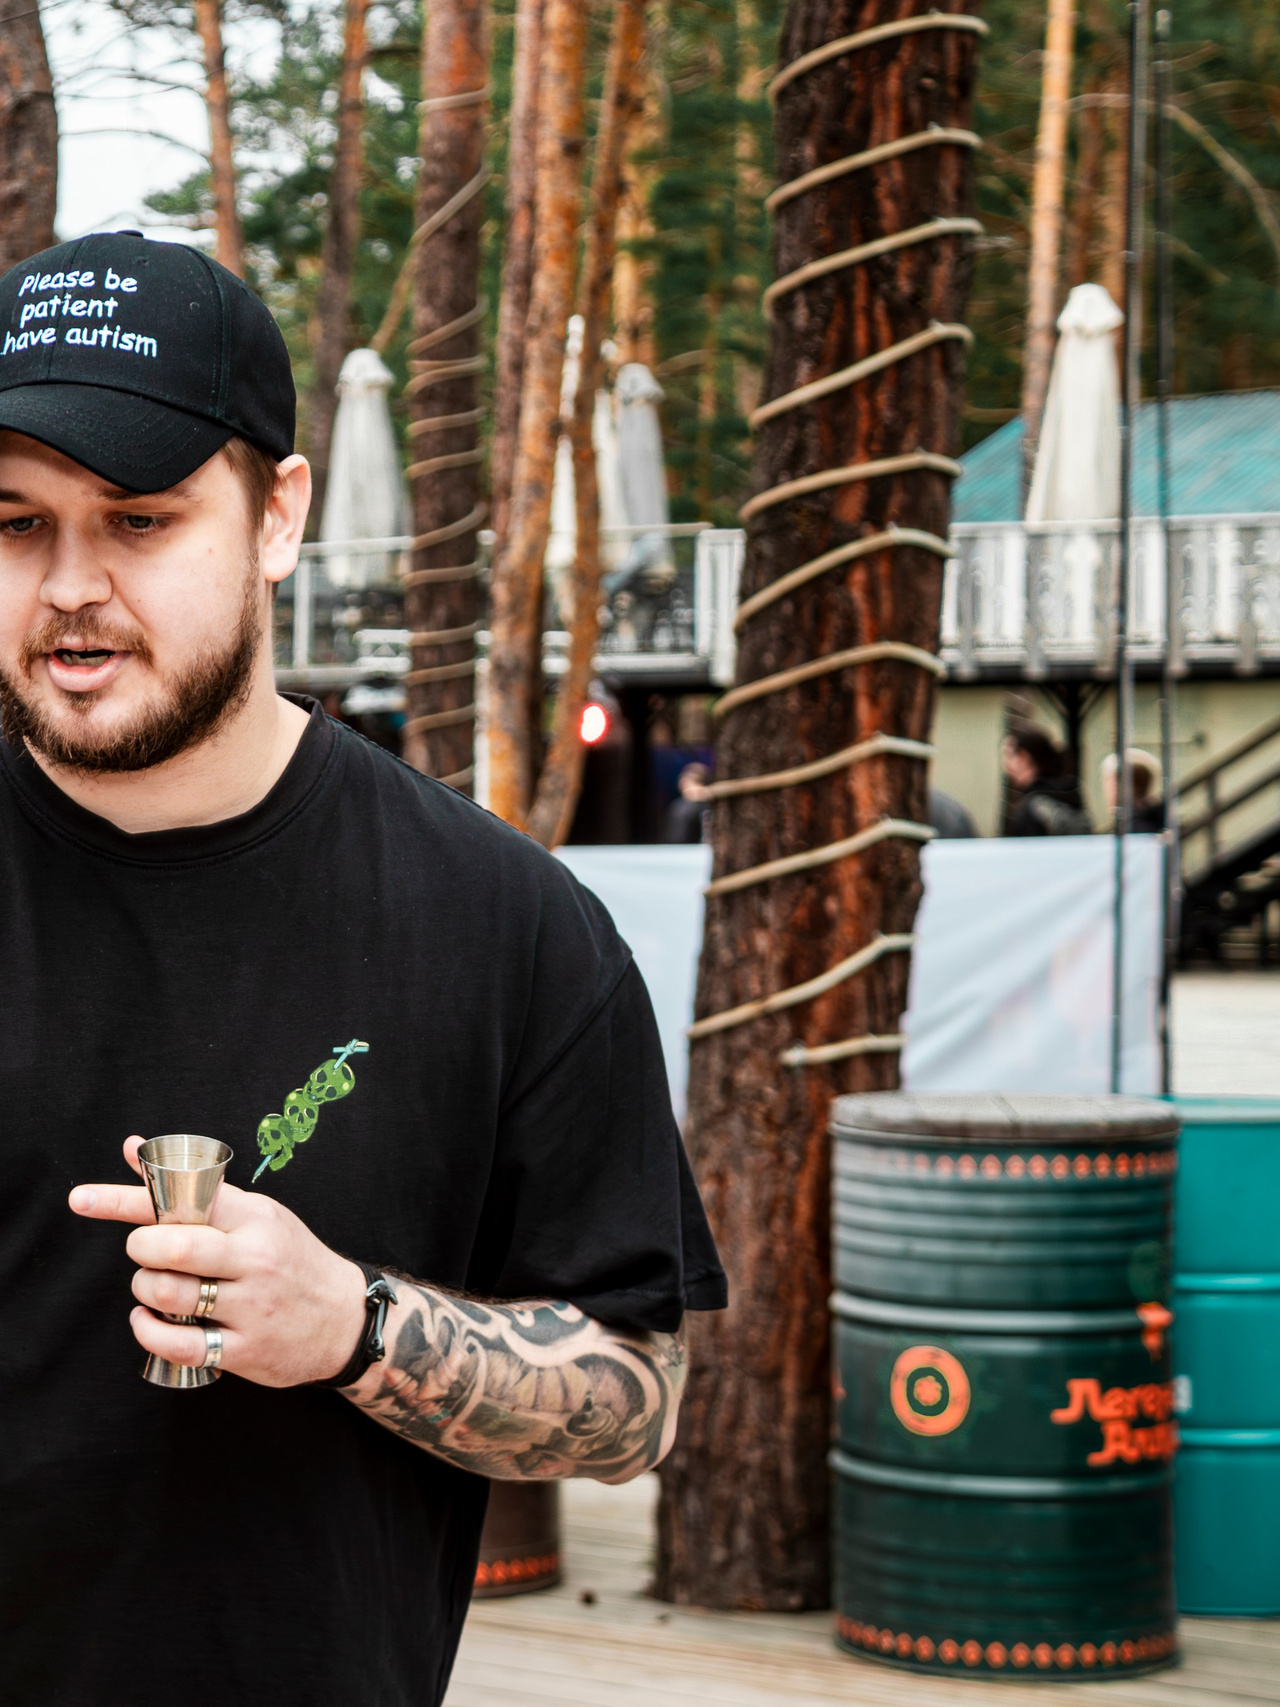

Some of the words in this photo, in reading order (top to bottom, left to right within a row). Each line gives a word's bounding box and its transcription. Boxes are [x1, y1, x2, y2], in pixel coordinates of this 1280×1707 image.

[18, 270, 95, 297] Please
[104, 267, 138, 293] be
[20, 293, 118, 329] patient
[0, 327, 57, 356] have
[64, 323, 158, 358] autism
